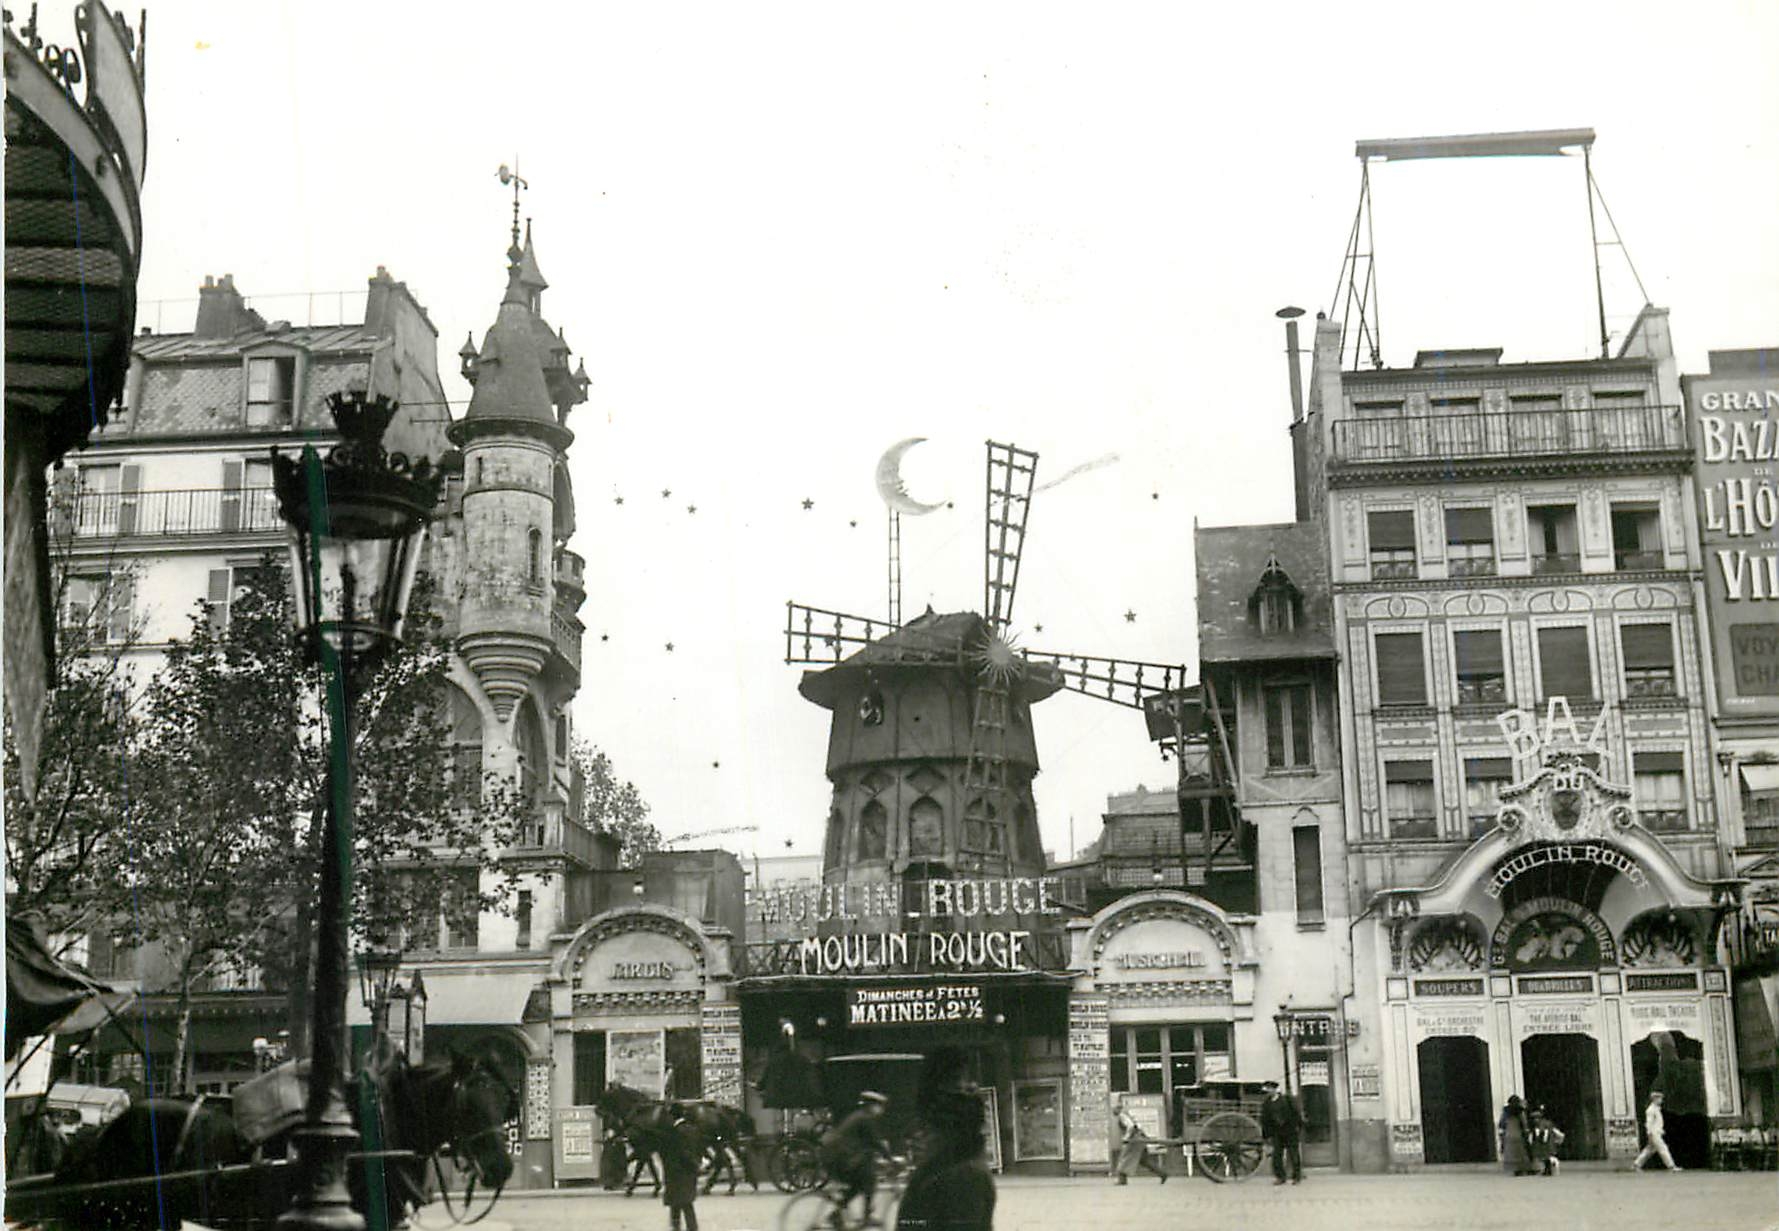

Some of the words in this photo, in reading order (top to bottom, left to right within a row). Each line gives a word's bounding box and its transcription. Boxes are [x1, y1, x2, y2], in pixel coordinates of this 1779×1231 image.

[1700, 416, 1779, 461] BAZ
[1496, 696, 1616, 758] BAL
[1554, 767, 1583, 791] DU
[756, 883, 898, 921] MOULIN
[929, 877, 1061, 917] ROUGE
[801, 932, 908, 974] MOULIN
[930, 931, 1030, 971] ROUGE
[857, 989, 924, 1003] DIMANCHES
